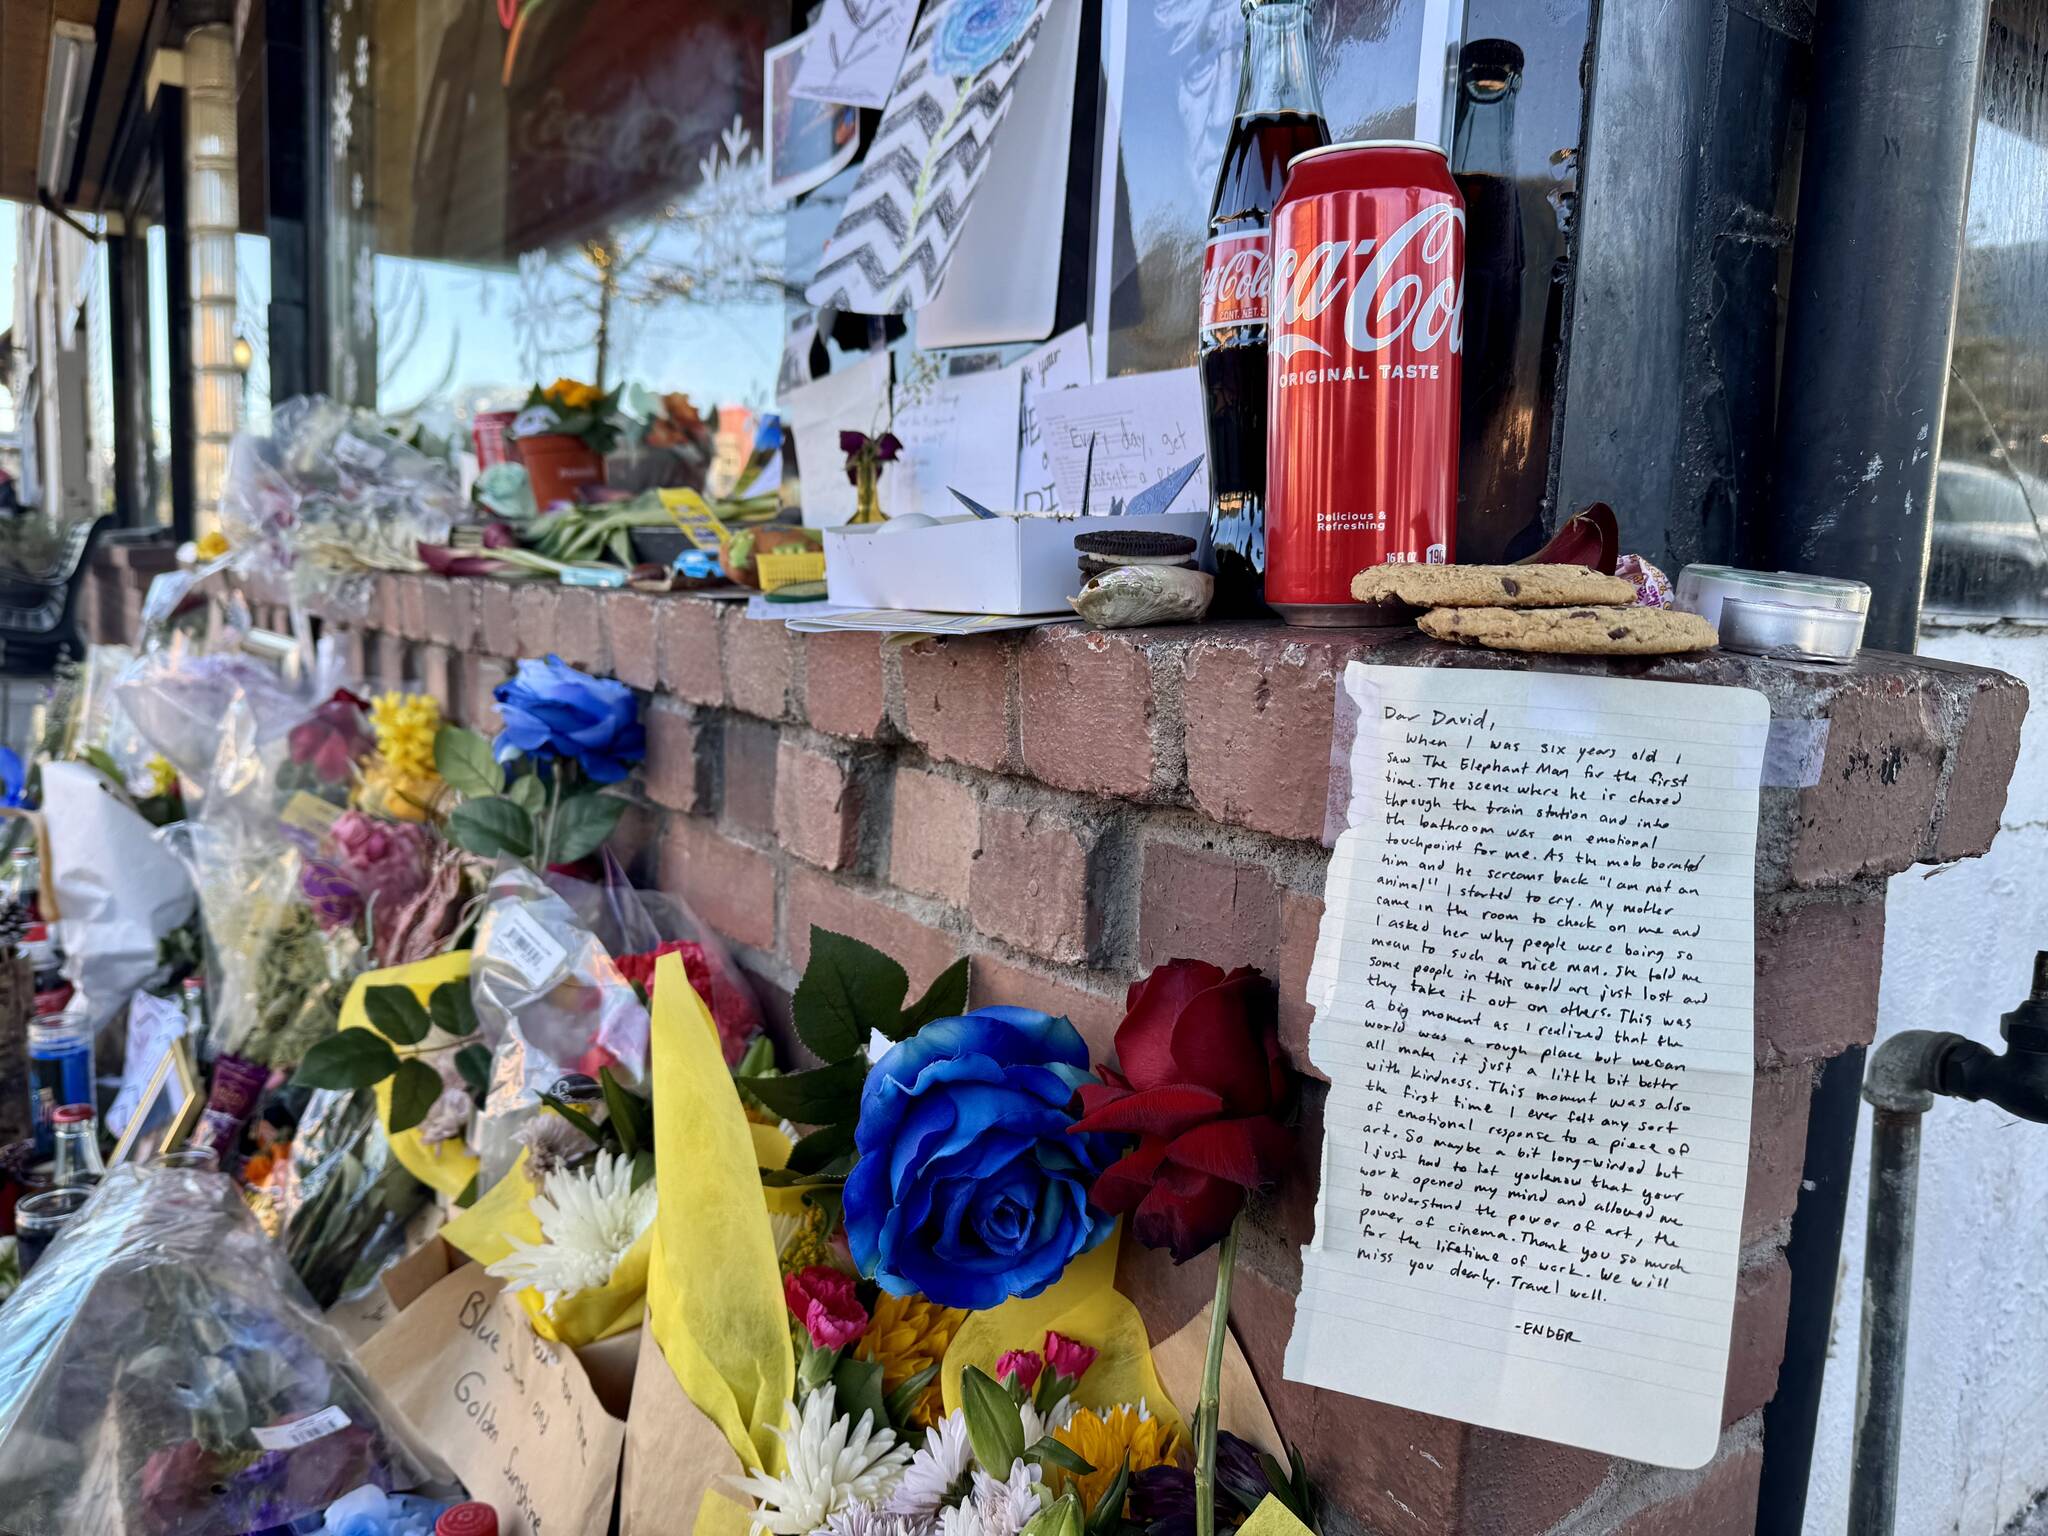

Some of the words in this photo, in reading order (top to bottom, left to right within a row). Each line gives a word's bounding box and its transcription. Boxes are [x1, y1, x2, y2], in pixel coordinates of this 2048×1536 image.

[1279, 366, 1370, 389] ORIGINAL
[1379, 364, 1440, 381] TASTE
[1161, 421, 1187, 456] get
[1316, 512, 1375, 522] Delicious
[1378, 510, 1387, 520] &
[1316, 521, 1386, 532] Refreshing
[1386, 552, 1397, 563] 16
[1432, 709, 1495, 731] David,
[1422, 755, 1447, 769] The
[1460, 758, 1529, 774] Elephant
[1536, 763, 1568, 778] Man
[1584, 764, 1604, 778] for
[1649, 771, 1688, 787] first
[1490, 740, 1520, 752] was
[1541, 743, 1566, 755] six
[1632, 748, 1657, 763] old
[1386, 770, 1421, 788] time.
[1427, 777, 1455, 790] The
[1468, 781, 1509, 792] scene
[1518, 783, 1558, 796] where
[1570, 787, 1586, 800] he
[1385, 790, 1441, 812] through
[1486, 800, 1523, 815] train
[1537, 804, 1587, 820] station
[1600, 815, 1627, 825] and
[1637, 818, 1669, 829] into
[1386, 832, 1462, 855] touchpoint
[1474, 842, 1497, 855] for
[1505, 850, 1536, 860] me.
[1543, 848, 1563, 862] As
[1607, 855, 1641, 867] mob
[1420, 814, 1494, 834] bathroom
[1586, 834, 1657, 849] emotional
[1382, 854, 1408, 867] him
[1419, 860, 1444, 871] and
[1456, 862, 1471, 876] he
[1554, 870, 1588, 885] back
[1646, 880, 1671, 894] not
[1678, 887, 1699, 896] an
[1377, 896, 1409, 909] came
[1482, 911, 1518, 920] room
[1533, 912, 1546, 924] to
[1672, 924, 1700, 937] and
[1460, 884, 1512, 900] started
[1526, 890, 1541, 903] to
[1548, 896, 1581, 910] cry.
[1590, 899, 1614, 917] My
[1623, 901, 1674, 915] mother
[1388, 920, 1429, 932] asked
[1443, 925, 1469, 938] her
[1480, 929, 1514, 951] why
[1523, 936, 1566, 955] people
[1578, 944, 1612, 953] were
[1677, 951, 1693, 960] so
[1422, 940, 1435, 954] to
[1452, 949, 1483, 961] such
[1521, 957, 1557, 971] nice
[1567, 964, 1607, 976] man.
[1413, 964, 1454, 981] people
[1464, 969, 1476, 981] in
[1524, 977, 1561, 992] world
[1600, 984, 1632, 1002] just
[1644, 986, 1673, 1002] lost
[1365, 1000, 1375, 1010] a
[1388, 1000, 1408, 1018] big
[1422, 1009, 1481, 1025] moment
[1494, 1021, 1509, 1031] as
[1539, 1022, 1603, 1041] realized
[1615, 1030, 1648, 1045] that
[1411, 979, 1445, 997] take
[1460, 988, 1476, 1003] it
[1488, 996, 1517, 1008] out
[1528, 1004, 1548, 1013] on
[1560, 1001, 1611, 1019] others.
[1620, 1009, 1652, 1027] This
[1663, 1017, 1691, 1029] was
[1365, 1020, 1405, 1032] world
[1486, 1043, 1528, 1060] rough
[1540, 1045, 1582, 1063] place
[1595, 1051, 1621, 1064] but
[1366, 1039, 1385, 1051] all
[1452, 1052, 1468, 1065] it
[1478, 1057, 1511, 1074] just
[1607, 1072, 1629, 1086] bit
[1367, 1059, 1400, 1074] with
[1411, 1065, 1479, 1090] kindness.
[1489, 1080, 1525, 1098] This
[1610, 1099, 1646, 1108] was
[1655, 1096, 1690, 1112] also
[1367, 1101, 1382, 1112] of
[1398, 1109, 1473, 1130] emotional
[1489, 1127, 1555, 1144] response
[1562, 1129, 1576, 1143] to
[1610, 1137, 1661, 1154] piece
[1668, 1143, 1689, 1156] of
[1403, 1084, 1438, 1104] first
[1454, 1095, 1493, 1113] time
[1528, 1109, 1557, 1120] ever
[1568, 1111, 1594, 1124] felt
[1601, 1118, 1629, 1132] any
[1638, 1121, 1678, 1134] sort
[1363, 1124, 1397, 1138] art.
[1406, 1129, 1423, 1143] So
[1517, 1146, 1540, 1158] bit
[1655, 1163, 1683, 1179] but
[1373, 1145, 1407, 1160] just
[1418, 1154, 1441, 1167] had
[1453, 1161, 1467, 1172] to
[1591, 1175, 1633, 1193] that
[1642, 1189, 1684, 1206] your
[1413, 1177, 1463, 1192] opened
[1474, 1185, 1497, 1200] my
[1508, 1189, 1547, 1202] mind
[1557, 1192, 1586, 1206] and
[1360, 1183, 1372, 1197] to
[1508, 1214, 1560, 1228] power
[1573, 1220, 1596, 1232] of
[1605, 1226, 1643, 1247] art,
[1363, 1224, 1387, 1238] for
[1437, 1240, 1499, 1262] lifetime
[1511, 1255, 1527, 1267] of
[1539, 1262, 1590, 1277] work.
[1631, 1274, 1669, 1289] will
[1415, 1216, 1434, 1228] of
[1449, 1223, 1515, 1242] cinema.
[1521, 1231, 1570, 1253] Thank
[1580, 1246, 1610, 1263] you
[1409, 1259, 1434, 1276] you
[1450, 1260, 1500, 1289] dearly.
[1511, 1276, 1559, 1294] Travel
[458, 1290, 501, 1354] Blue
[1515, 1322, 1581, 1342] -ENDER
[454, 1370, 500, 1443] Golden
